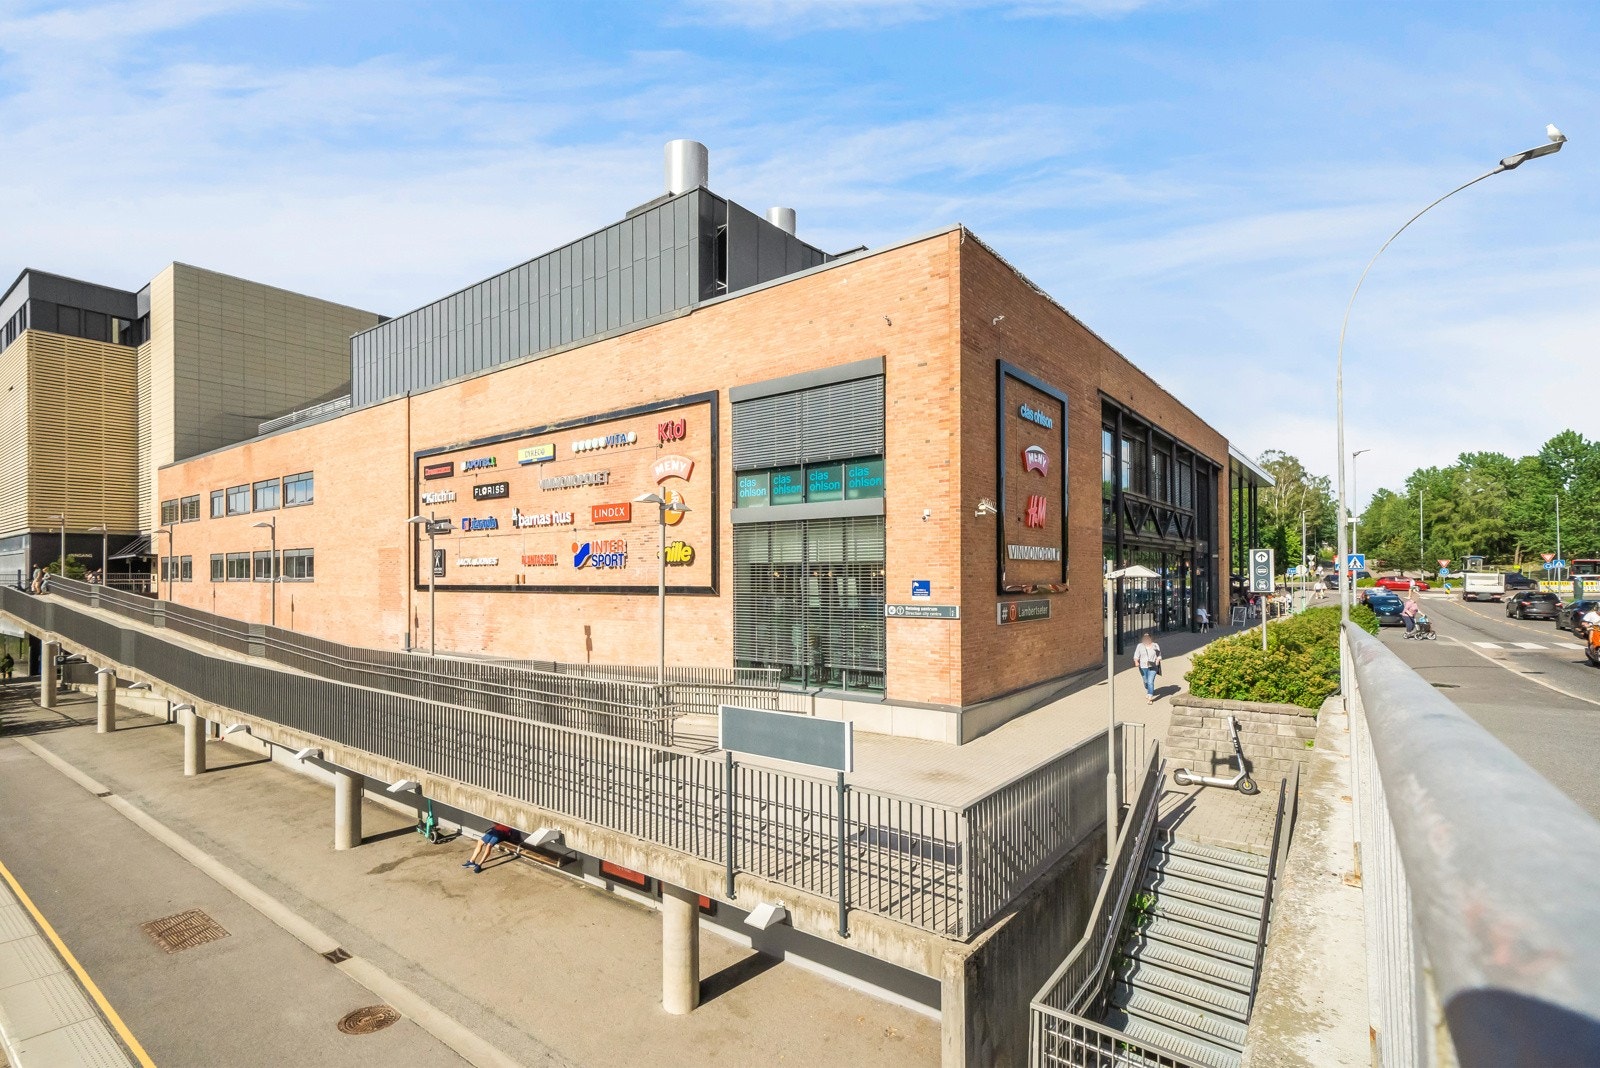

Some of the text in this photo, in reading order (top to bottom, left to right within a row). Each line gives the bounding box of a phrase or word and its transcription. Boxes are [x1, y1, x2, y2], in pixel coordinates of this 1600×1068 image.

[1020, 403, 1052, 429] clas ohlson
[658, 419, 684, 440] Kid
[606, 433, 626, 445] VITA
[1028, 452, 1046, 467] MENY
[655, 460, 687, 475] MENY
[849, 466, 869, 478] clas
[773, 475, 791, 485] clas
[809, 471, 828, 481] clas
[849, 476, 882, 488] ohlson
[740, 478, 756, 488] clas
[773, 484, 801, 494] ohlson
[809, 481, 840, 491] ohlson
[474, 485, 505, 496] FLORISS
[740, 487, 766, 497] ohlson
[553, 511, 572, 524] hus
[594, 507, 625, 518] LINDEX
[592, 540, 624, 553] INTER
[592, 554, 624, 567] SPORT
[1019, 605, 1049, 618] Lambertseter
